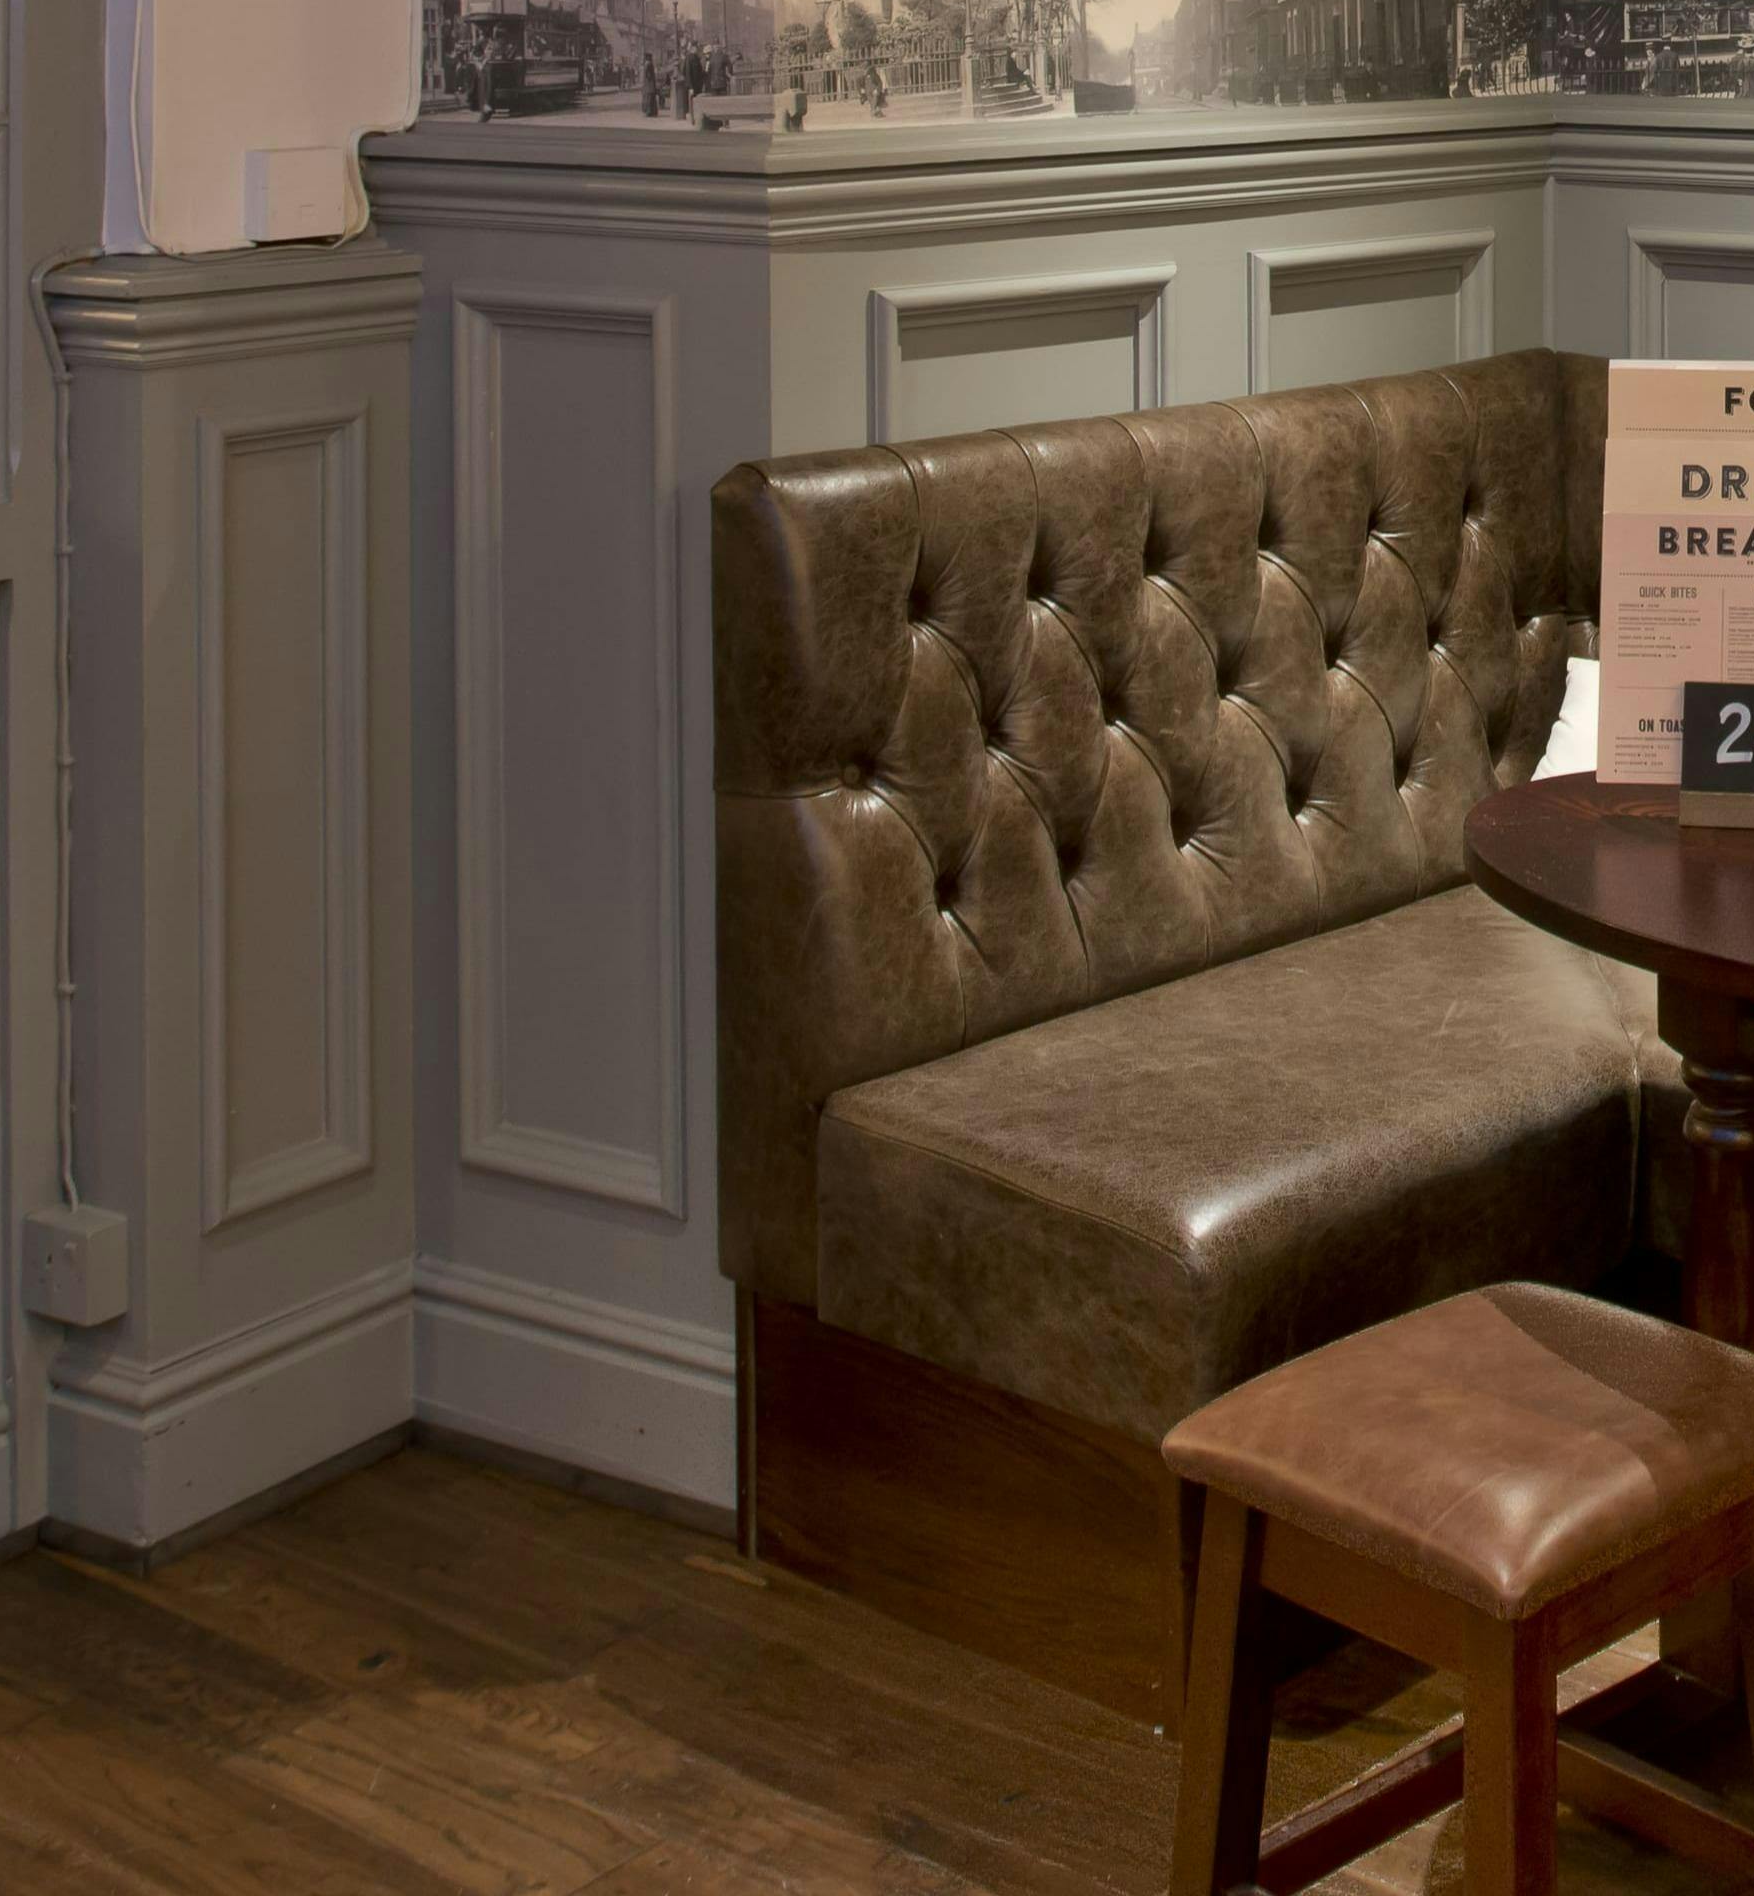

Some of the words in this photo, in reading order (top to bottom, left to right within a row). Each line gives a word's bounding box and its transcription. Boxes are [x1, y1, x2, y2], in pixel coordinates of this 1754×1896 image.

[1638, 585, 1666, 599] QUICK
[1670, 586, 1698, 600] BITES
[1638, 718, 1655, 733] ON
[1659, 718, 1687, 734] TOAS
